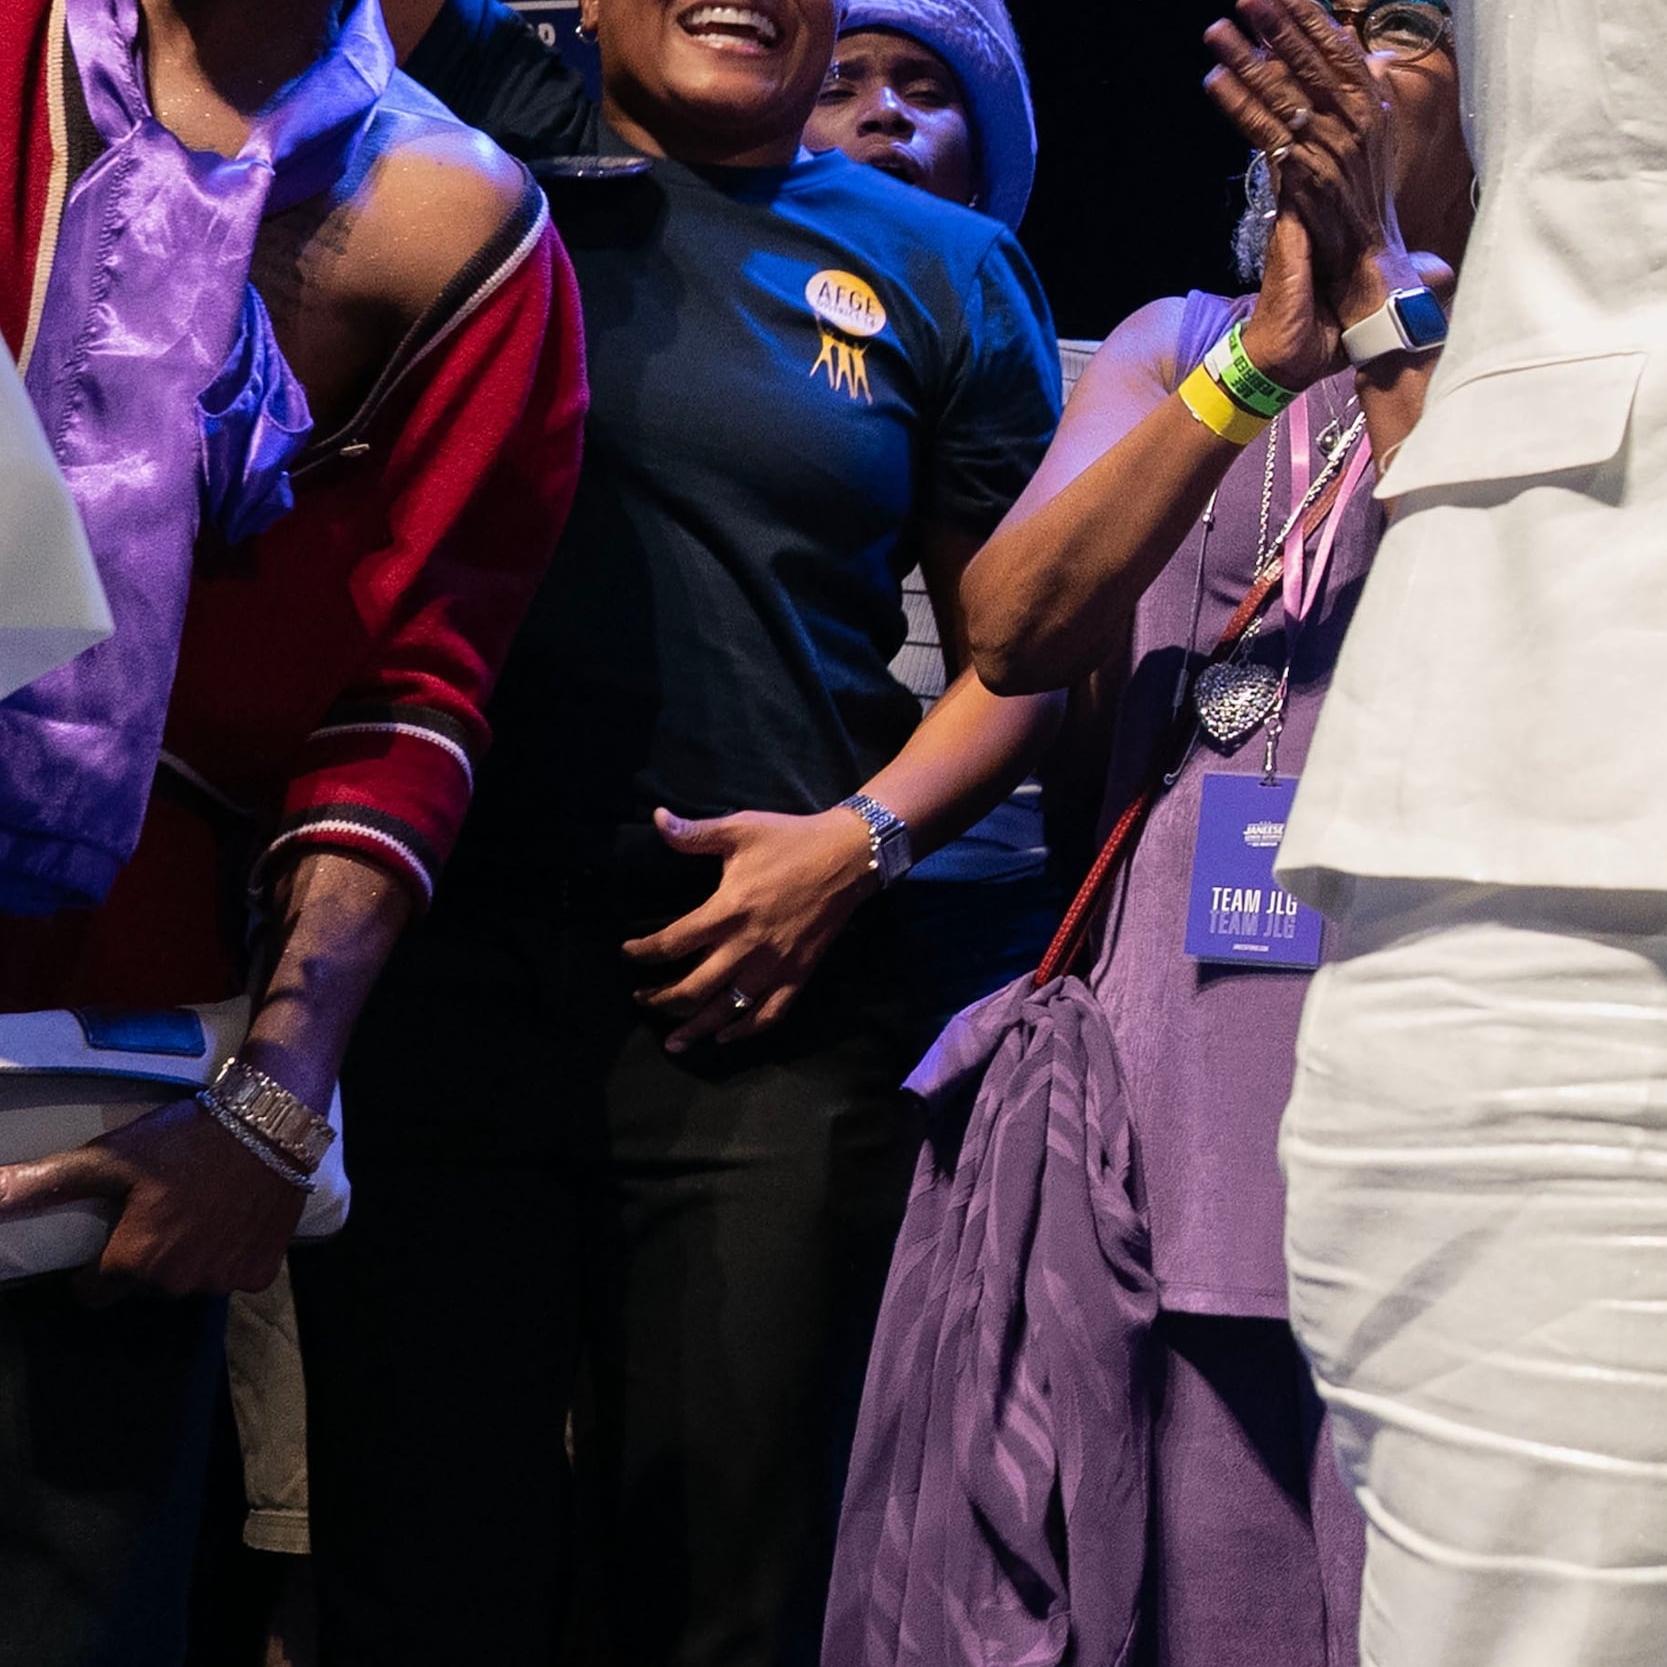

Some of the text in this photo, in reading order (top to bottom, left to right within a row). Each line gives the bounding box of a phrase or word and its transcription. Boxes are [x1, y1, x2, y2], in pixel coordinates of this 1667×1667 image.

[1212, 887, 1298, 916] TEAM JLG
[1209, 910, 1296, 939] TEAM JLG
